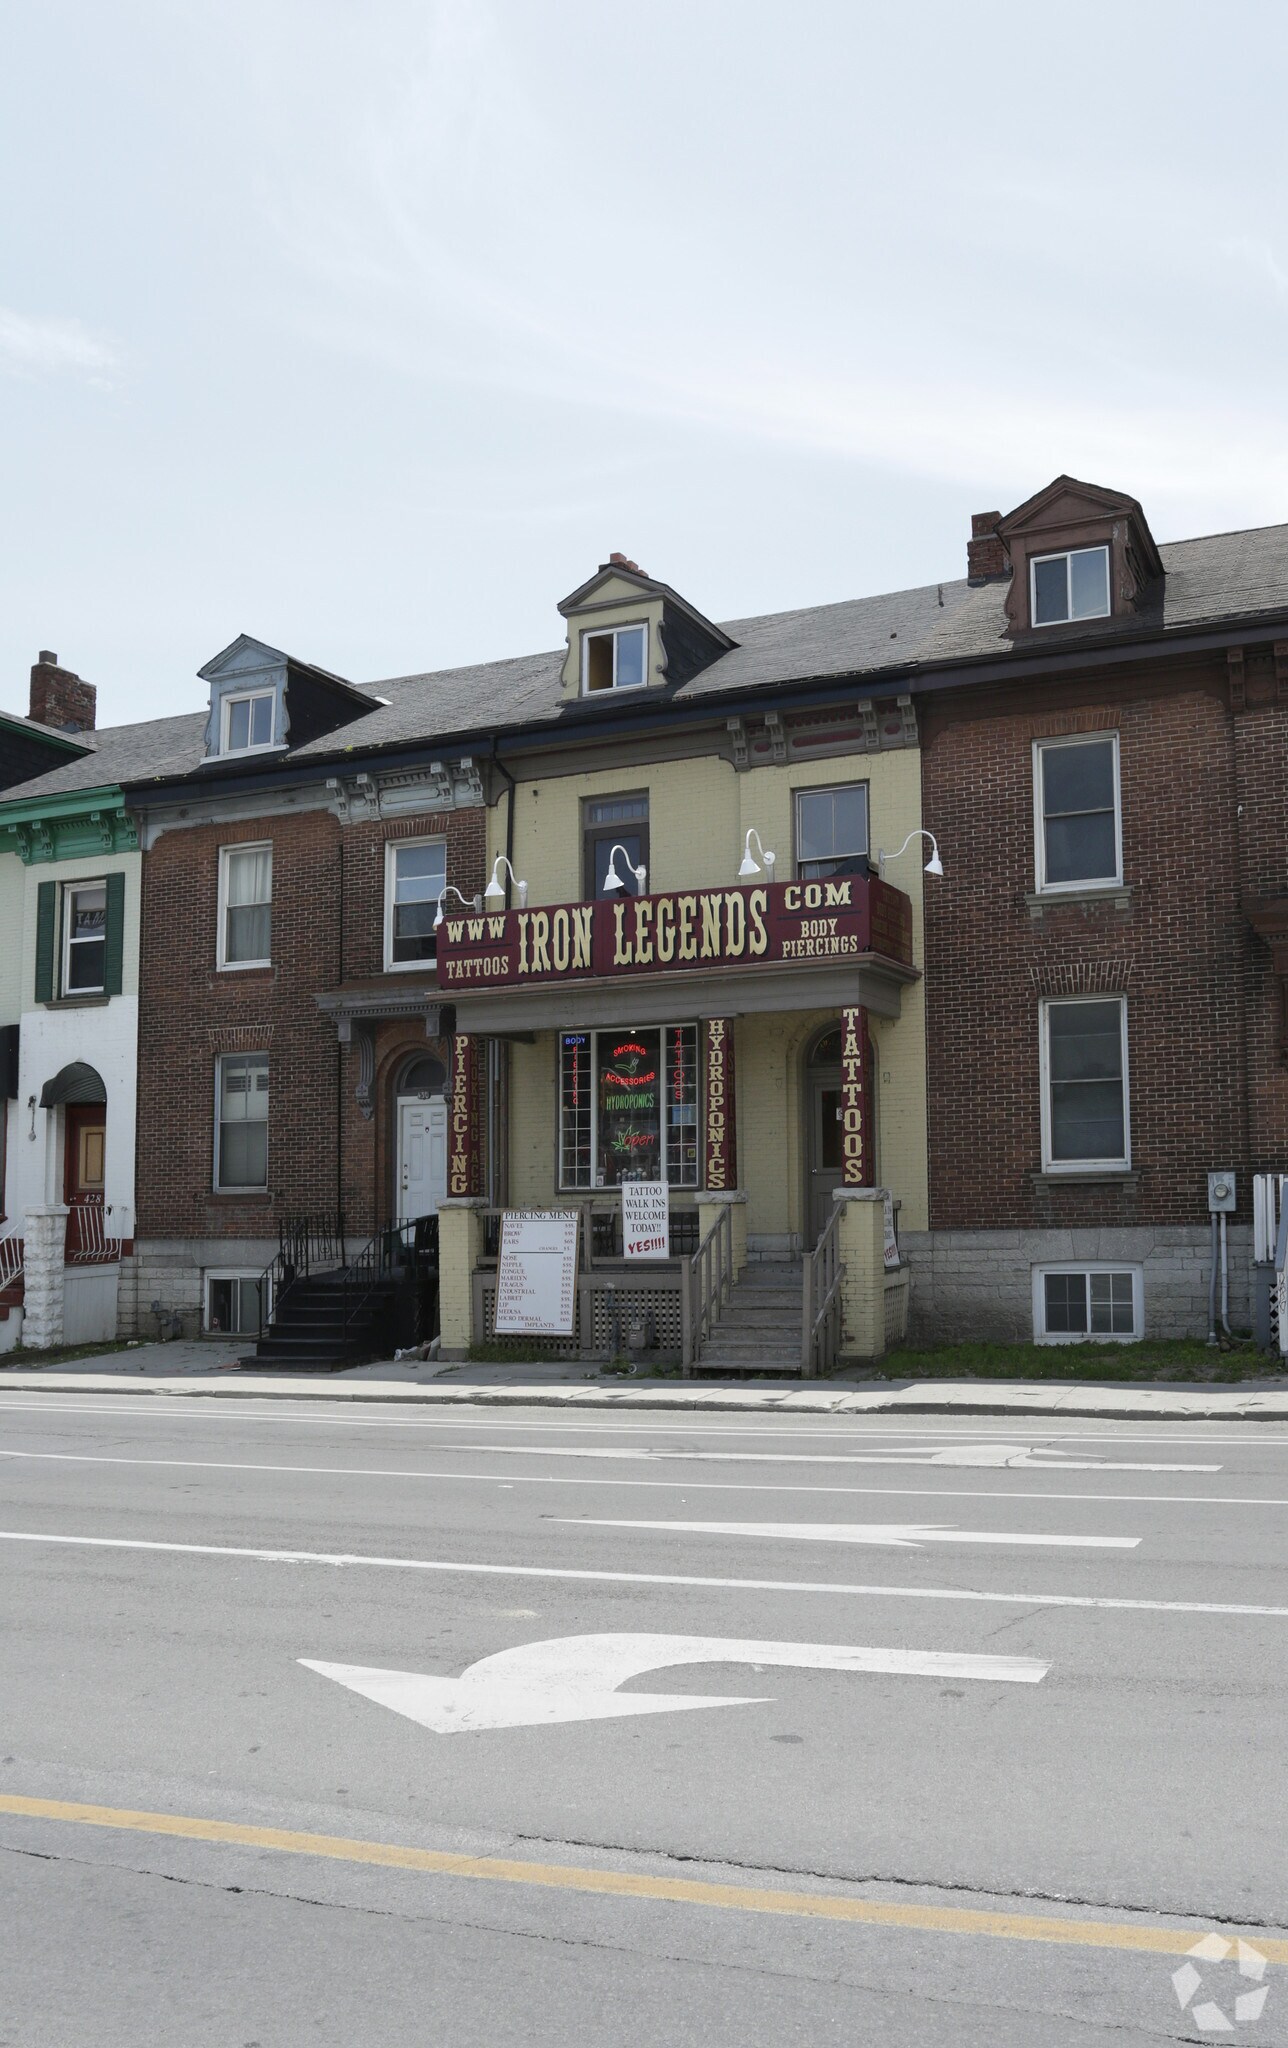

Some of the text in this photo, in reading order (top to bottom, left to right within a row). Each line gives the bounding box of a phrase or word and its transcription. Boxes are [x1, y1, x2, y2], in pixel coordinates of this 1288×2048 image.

[783, 880, 852, 910] COM
[445, 915, 506, 943] WWW
[518, 889, 768, 974] IRON LEGENDS
[800, 918, 838, 938] BODY
[781, 934, 858, 959] PIERCINGS
[446, 955, 509, 980] TATTOOS
[565, 1037, 586, 1045] BODY
[613, 1043, 647, 1057] SMOKING
[605, 1071, 656, 1086] ACCESSORIES
[606, 1092, 655, 1111] HYDROPONICS
[707, 1019, 726, 1190] HYDROPONICS
[843, 1008, 863, 1183] TATTOOS
[451, 1036, 468, 1194] PIERCING
[623, 1134, 655, 1152] open
[83, 1194, 102, 1204] 428
[629, 1186, 663, 1196] TATTOO
[625, 1198, 666, 1209] WALK INS
[504, 1211, 577, 1220] PIERCING MENU
[625, 1210, 667, 1221] WELCOME
[630, 1223, 662, 1233] TODAY!!
[628, 1236, 666, 1255] YES!!!!
